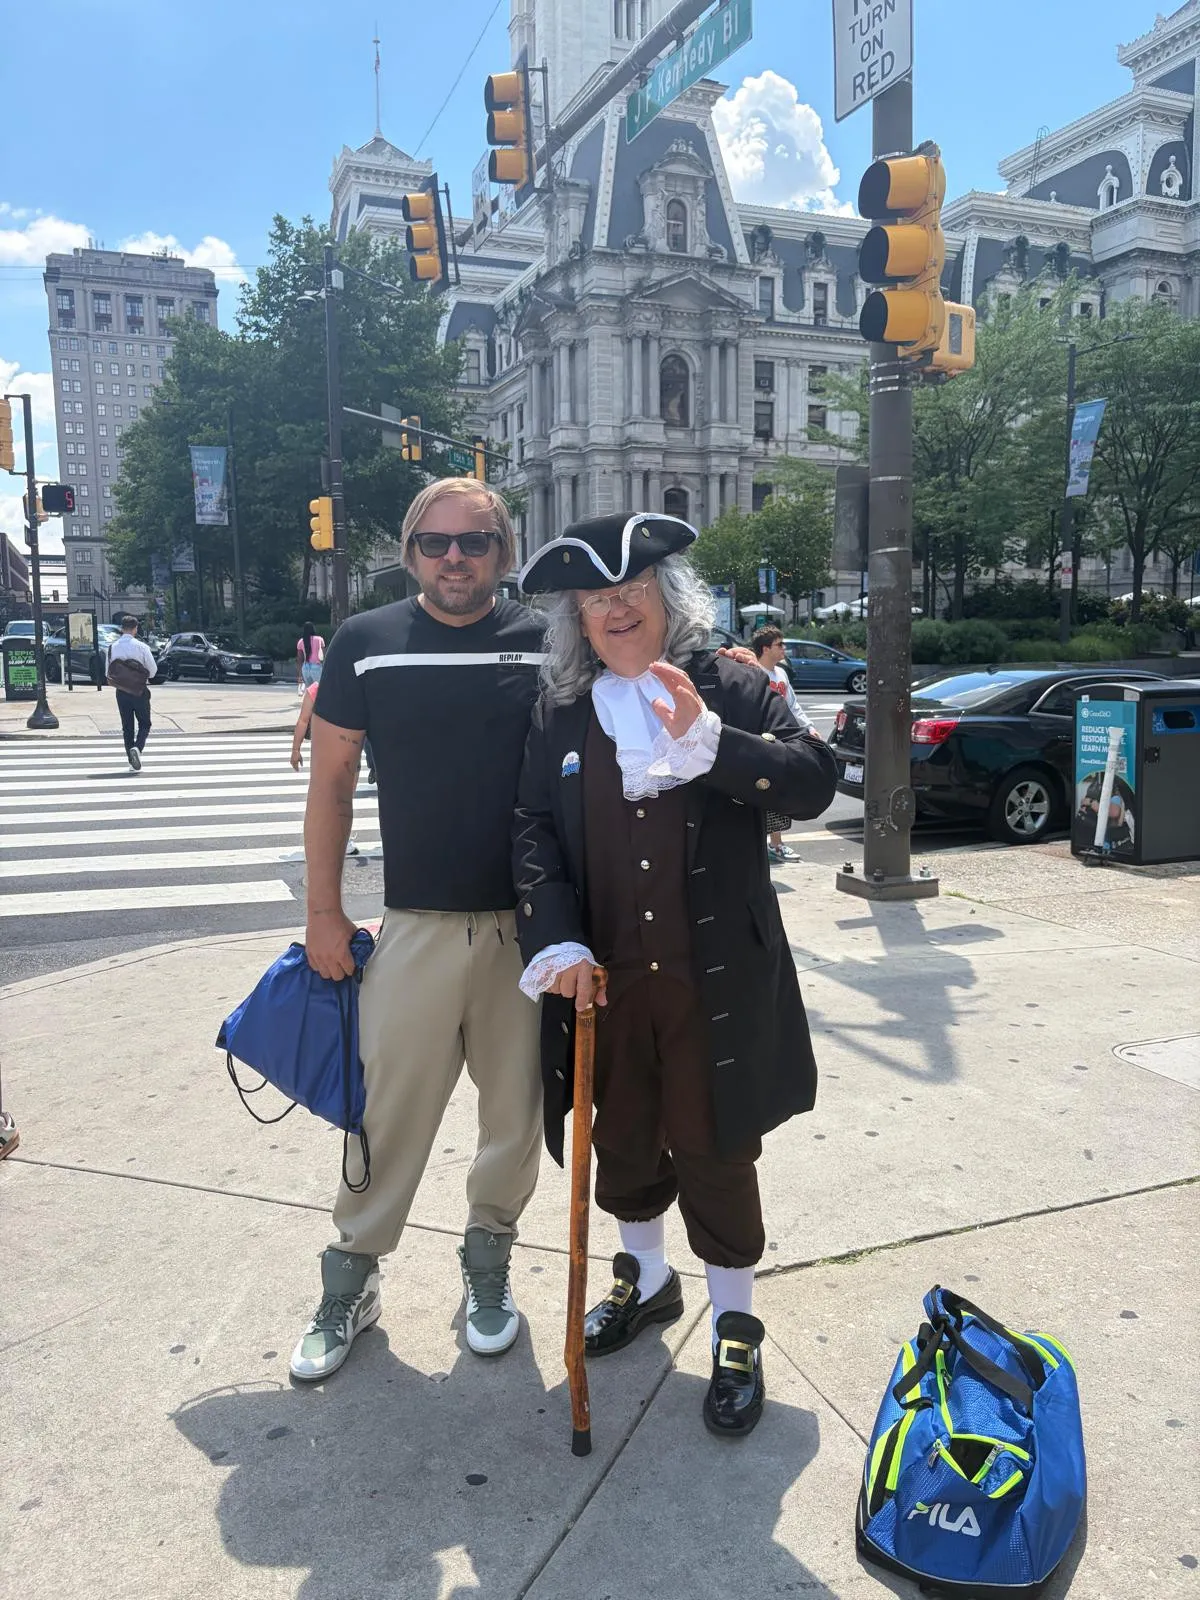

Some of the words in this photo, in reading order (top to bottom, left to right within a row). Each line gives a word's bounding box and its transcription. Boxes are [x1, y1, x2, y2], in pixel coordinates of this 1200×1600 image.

[849, 0, 896, 45] TURN
[860, 29, 884, 63] ON
[658, 30, 715, 102] Kennedy
[852, 50, 895, 102] RED
[499, 653, 523, 662] REPLAY
[1081, 725, 1105, 734] REDUCE
[1081, 735, 1106, 743] RESTORE
[1081, 744, 1101, 753] LEARN
